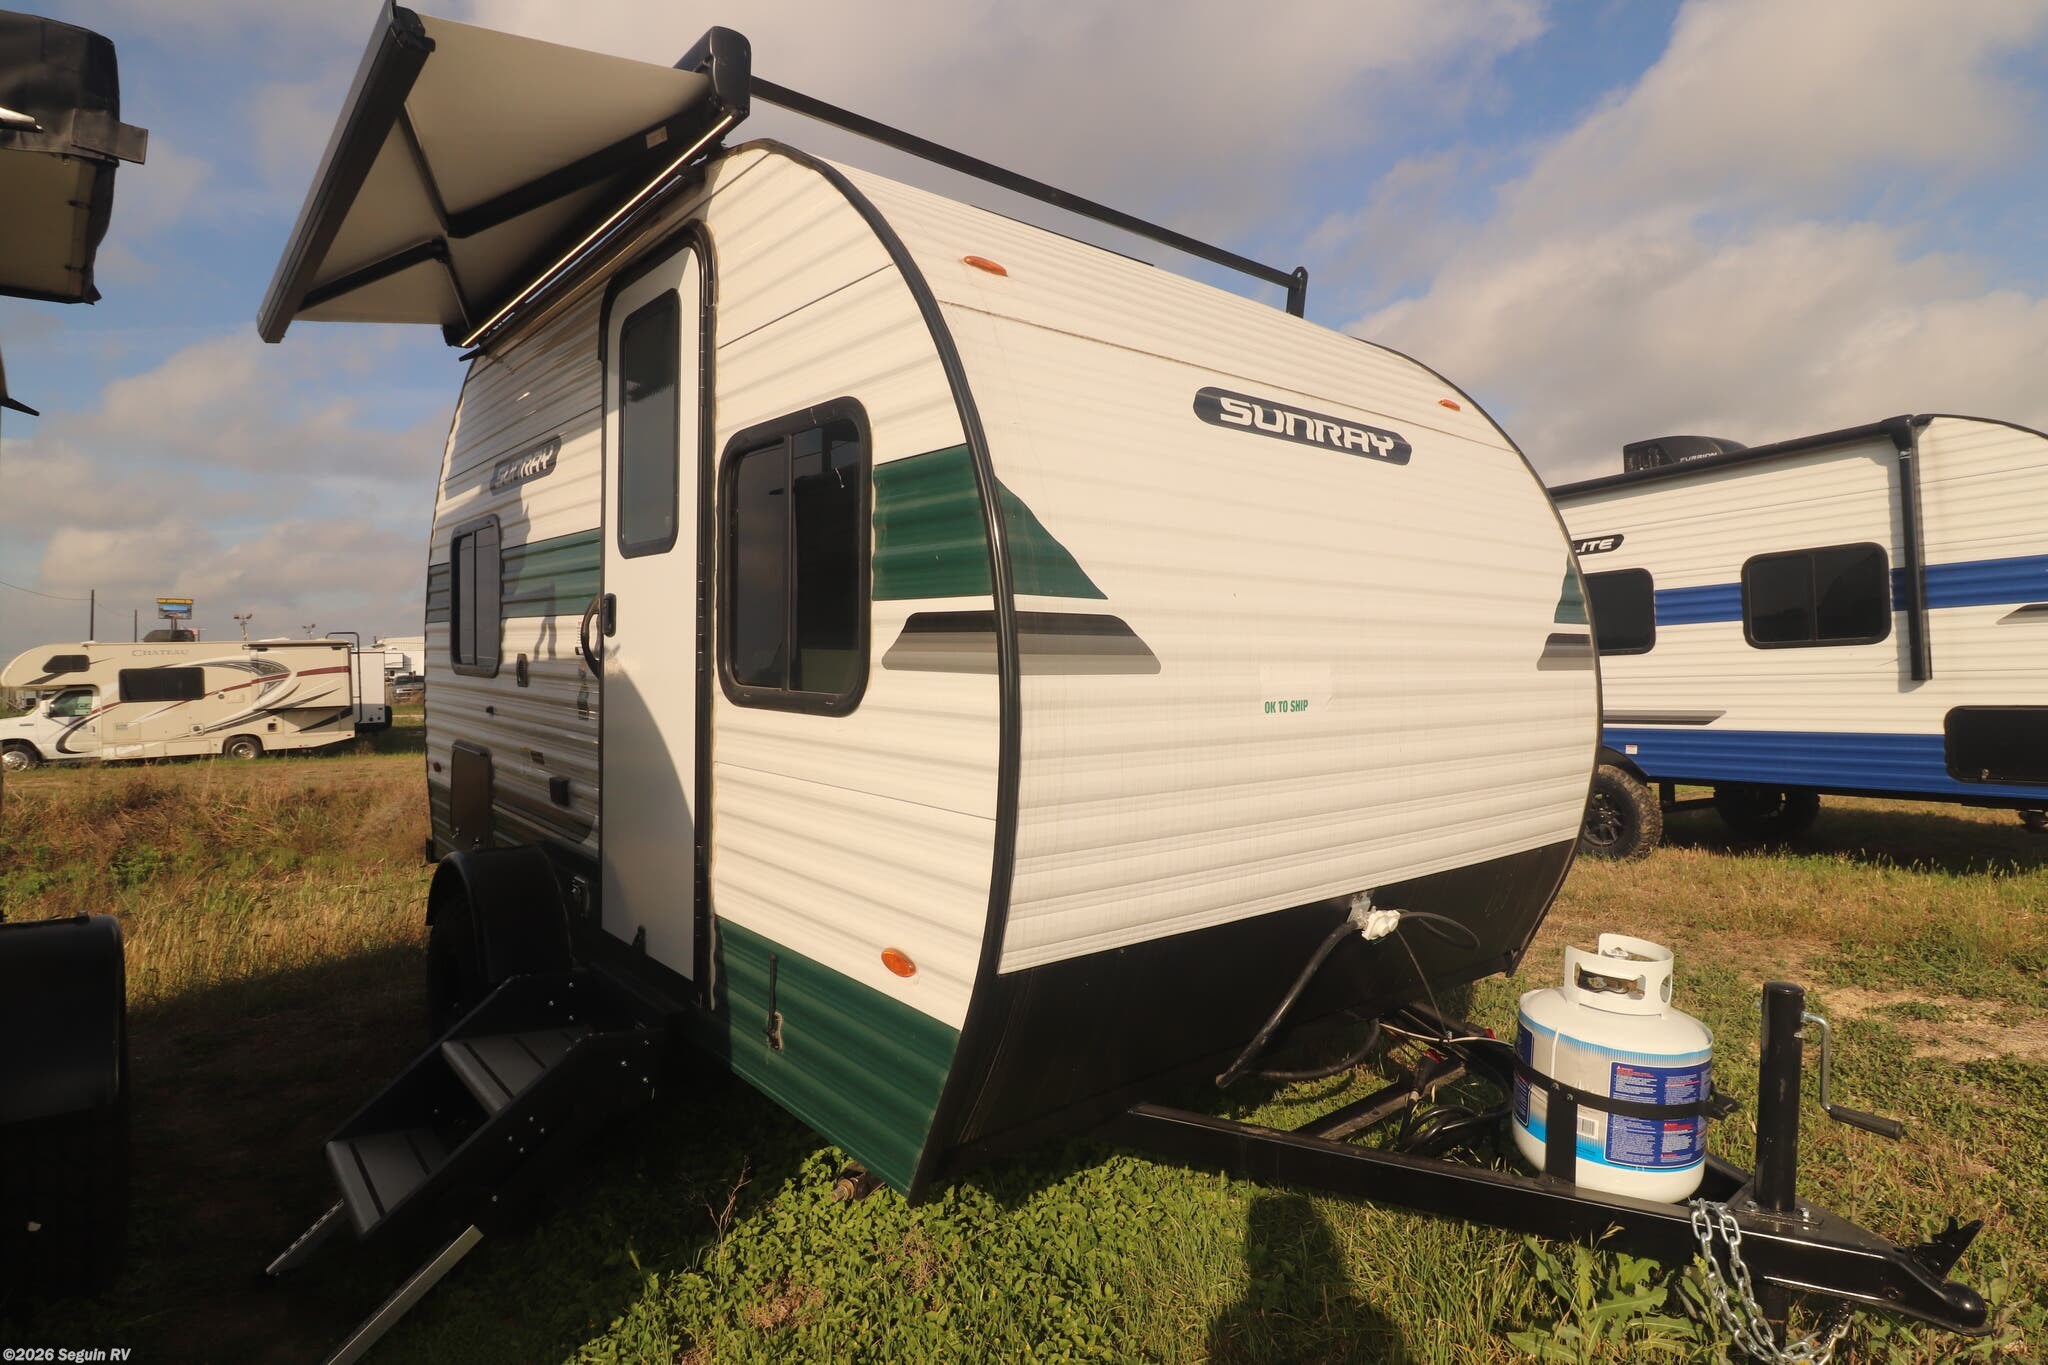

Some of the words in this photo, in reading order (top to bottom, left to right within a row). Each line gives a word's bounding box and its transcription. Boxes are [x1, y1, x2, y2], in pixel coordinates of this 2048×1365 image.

[1219, 396, 1395, 457] SUNRAY
[1264, 700, 1276, 714] OK
[1278, 700, 1288, 713] TO
[1290, 699, 1309, 713] SHIP
